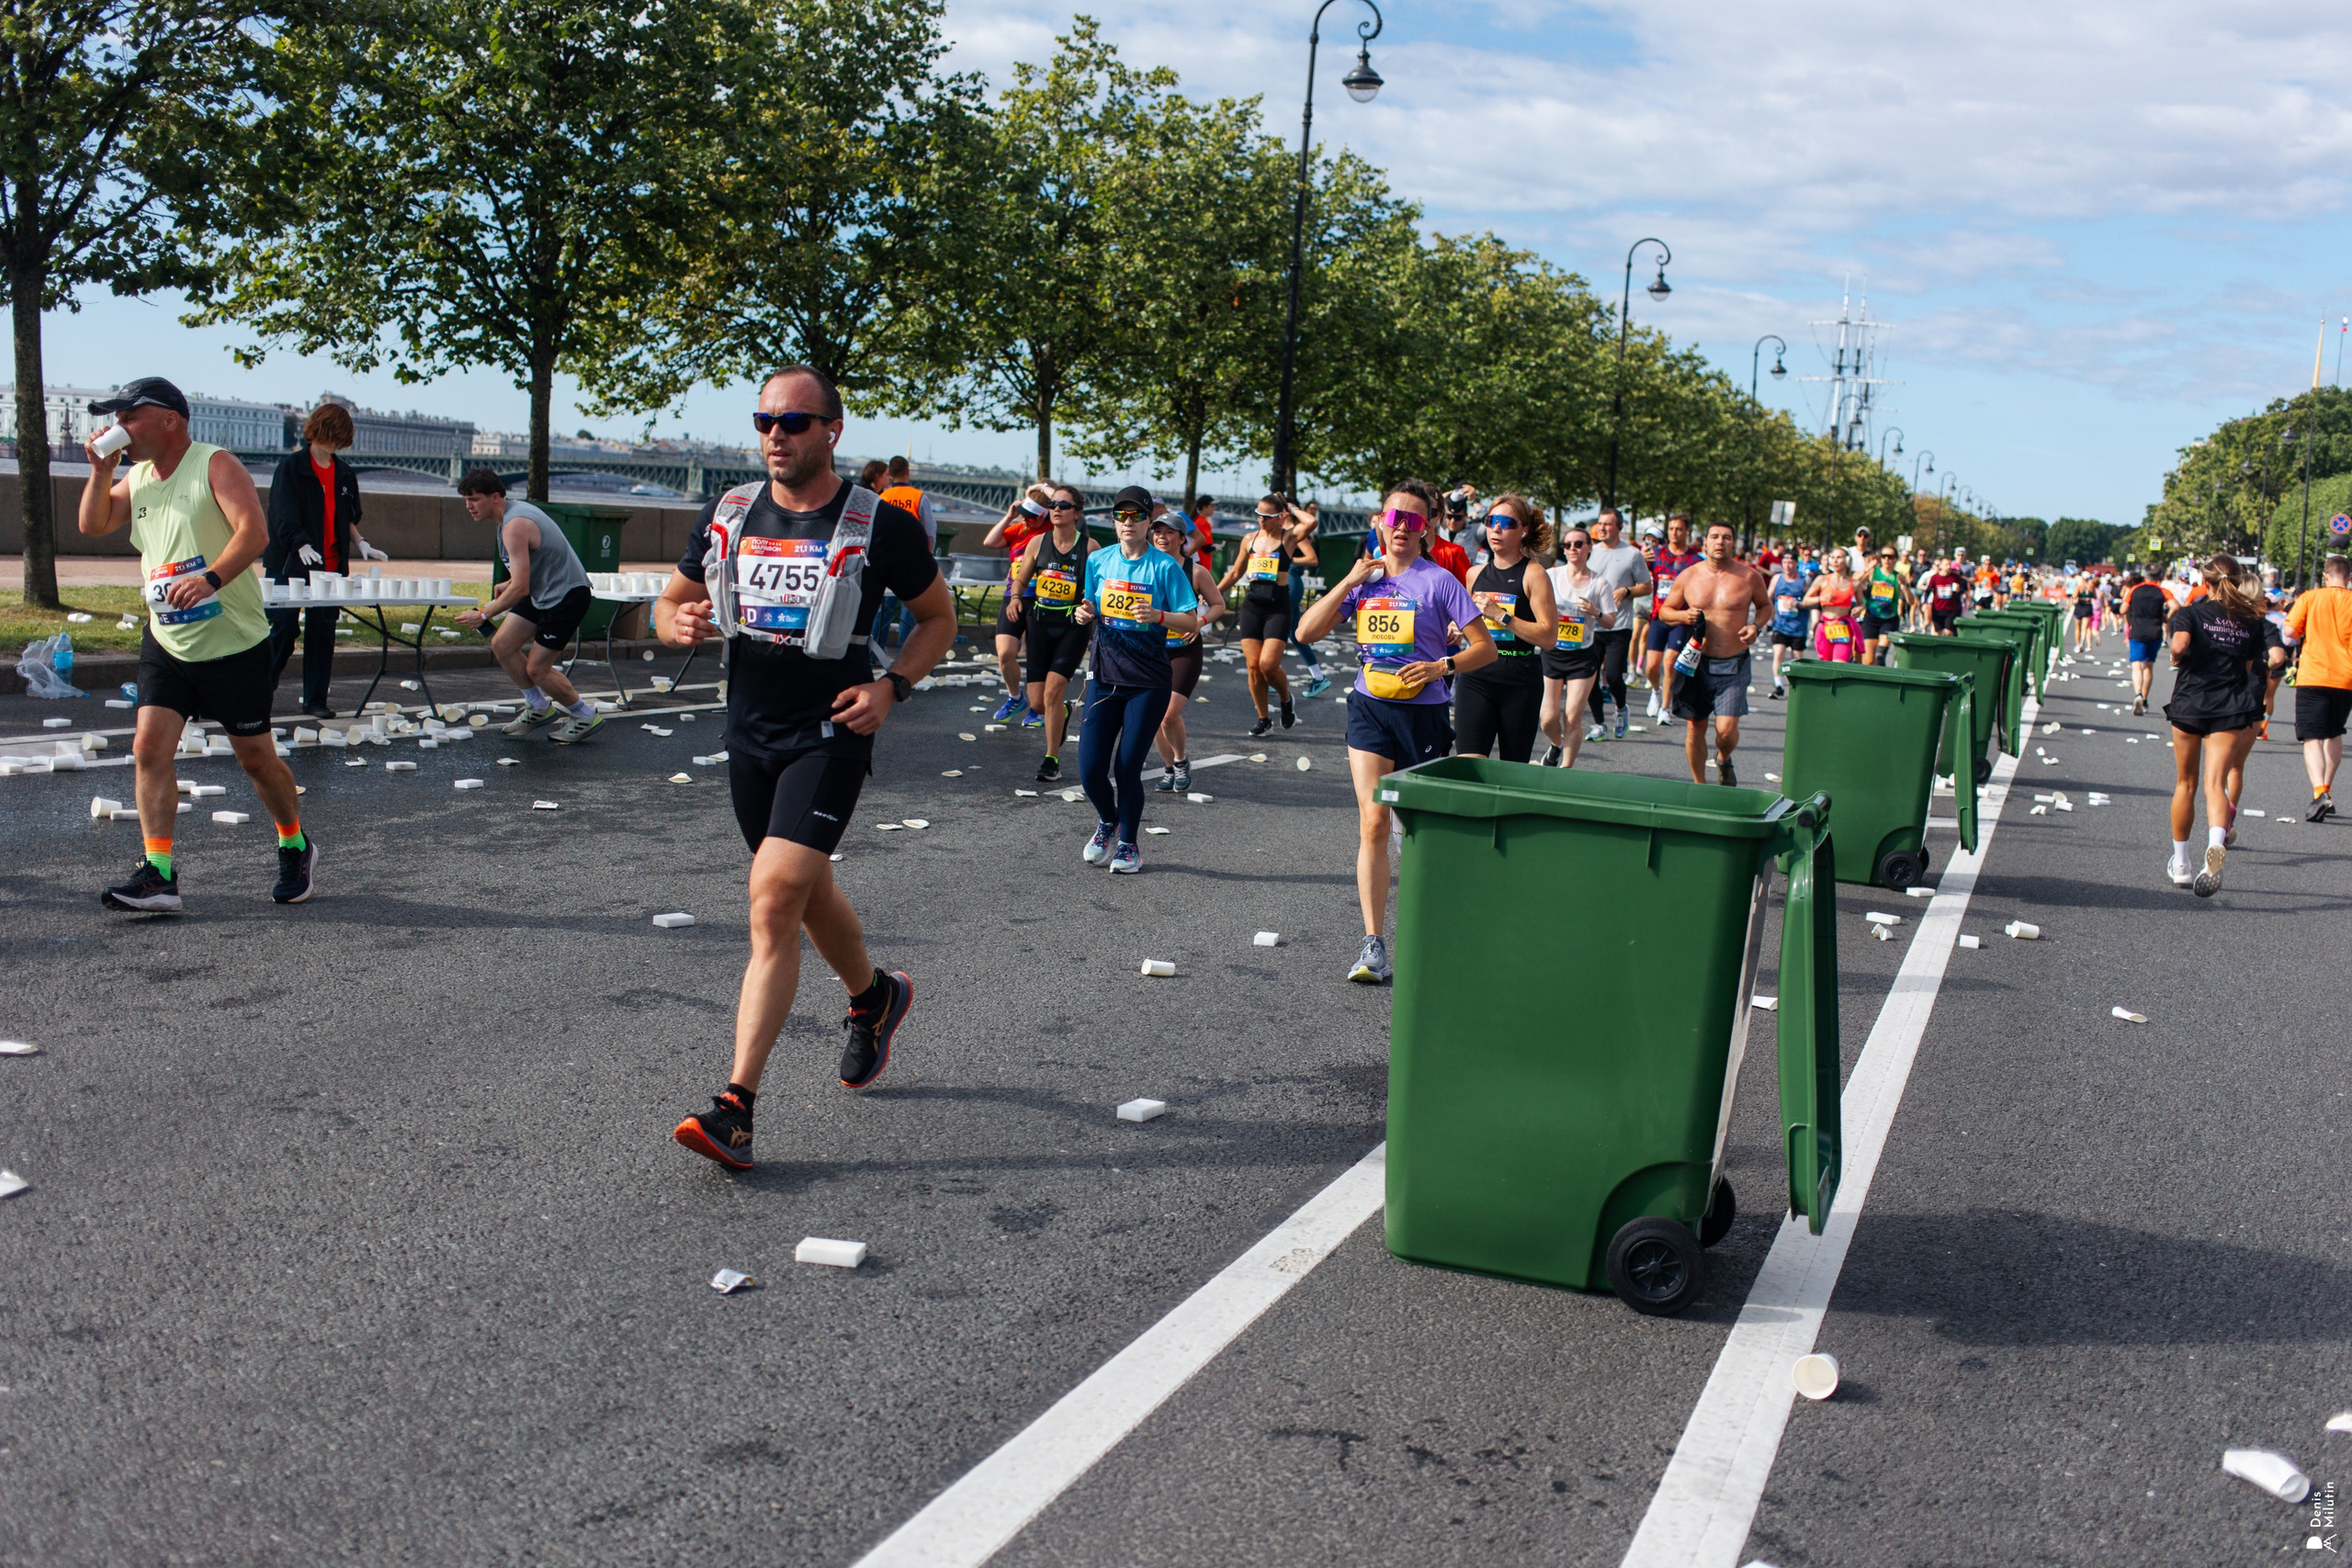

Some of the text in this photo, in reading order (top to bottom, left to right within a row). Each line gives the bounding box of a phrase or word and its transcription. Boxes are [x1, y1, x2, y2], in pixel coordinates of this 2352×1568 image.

[888, 499, 912, 509] ДЬЯ
[794, 545, 823, 553] 21,1 КМ
[186, 561, 197, 570] КМ
[749, 563, 820, 592] 4755
[1041, 580, 1071, 595] 4238
[1107, 593, 1145, 611] 282
[747, 608, 757, 623] D
[1104, 616, 1110, 626] E
[1368, 615, 1400, 633] 856
[1558, 624, 1579, 636] 778
[2203, 623, 2250, 638] Running club
